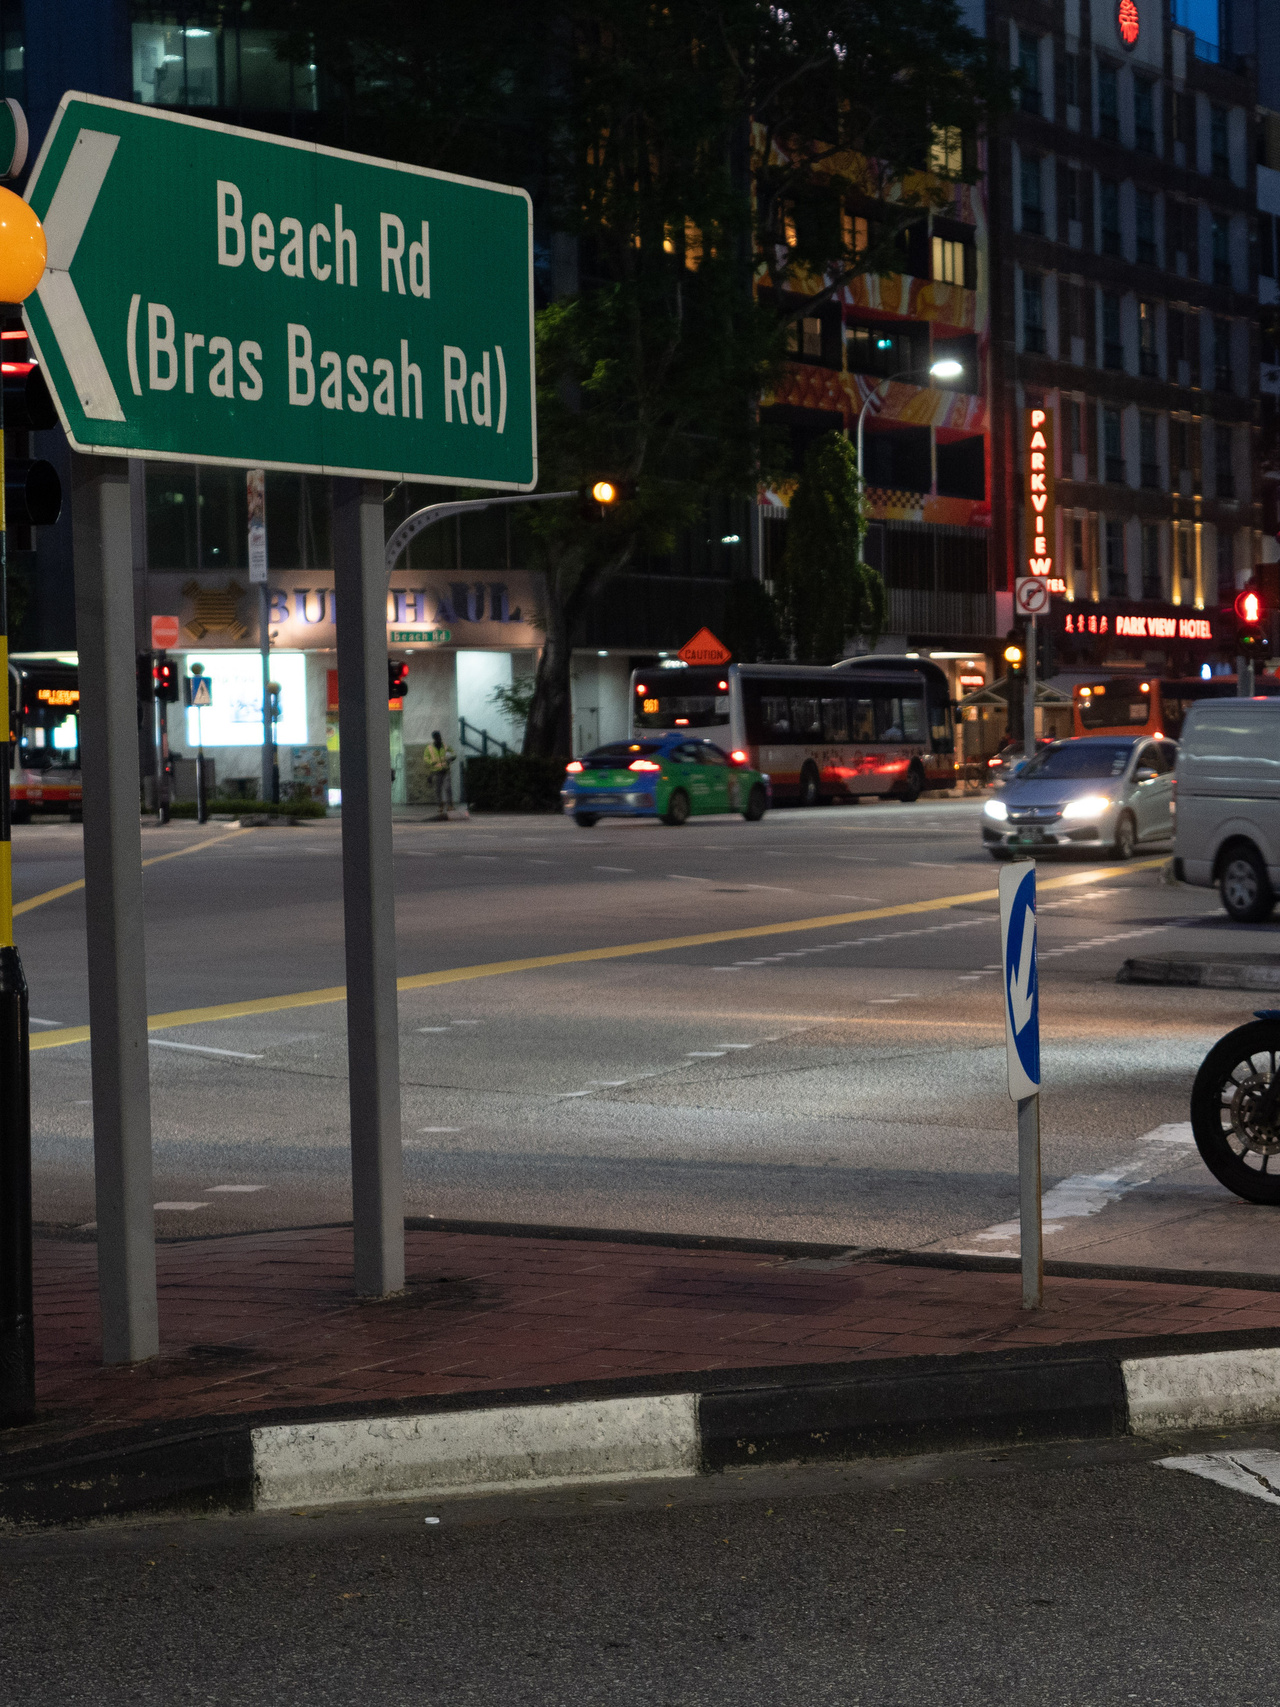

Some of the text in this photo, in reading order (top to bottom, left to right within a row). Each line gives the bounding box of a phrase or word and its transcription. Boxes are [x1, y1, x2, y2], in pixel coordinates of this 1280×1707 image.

[217, 180, 431, 299] Beach Rd
[127, 293, 507, 434] (Bras Basah Rd)
[1029, 410, 1051, 576] PARKVIEW
[1046, 578, 1067, 592] TEL
[1116, 616, 1213, 639] PARK VIEW HOTEL
[685, 649, 724, 660] CAUTION
[643, 699, 659, 713] 961
